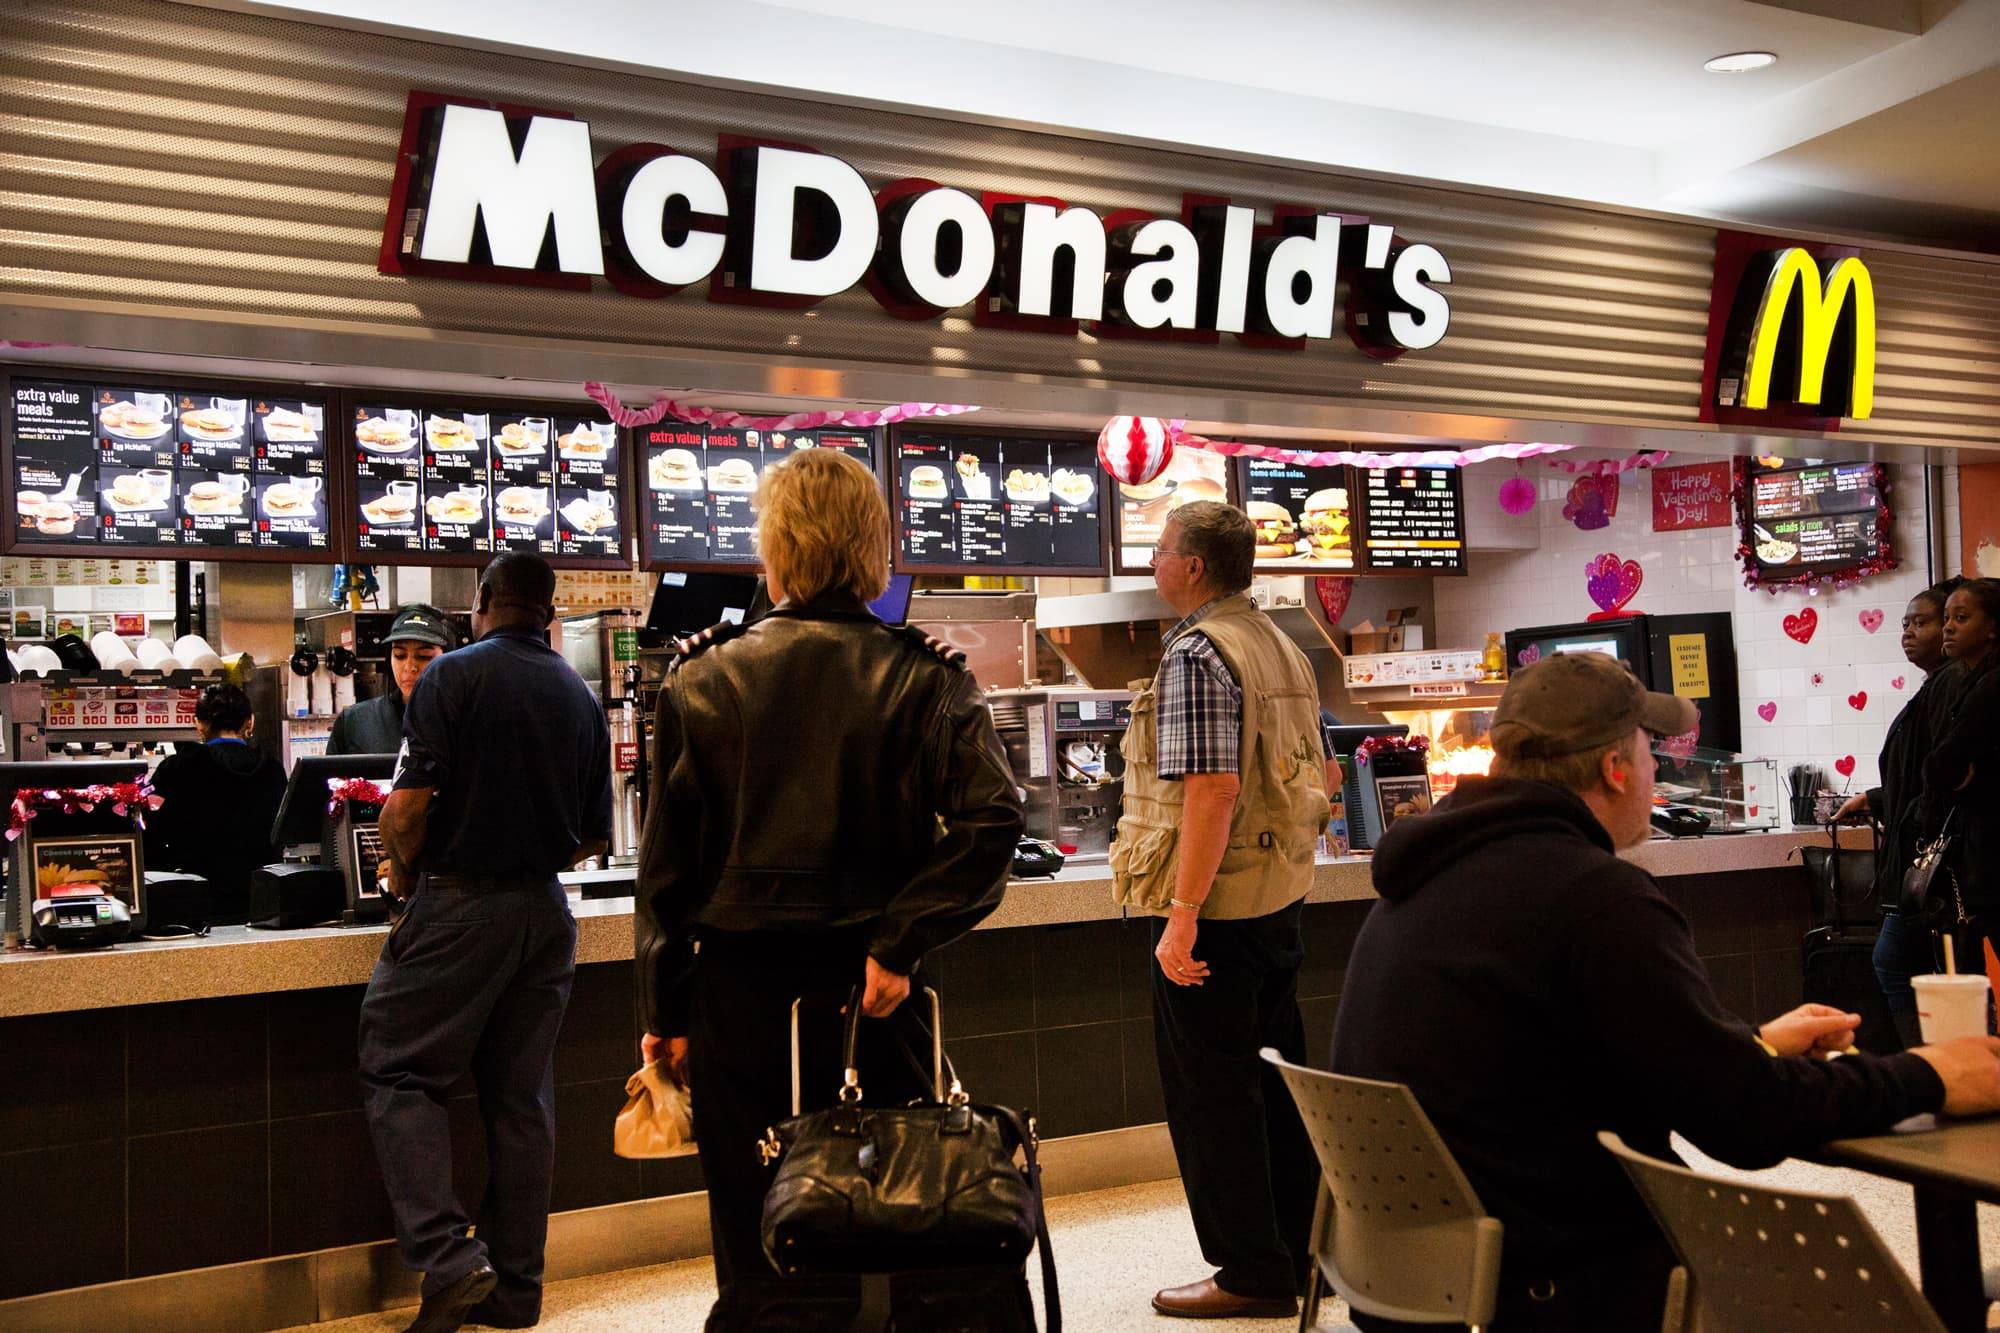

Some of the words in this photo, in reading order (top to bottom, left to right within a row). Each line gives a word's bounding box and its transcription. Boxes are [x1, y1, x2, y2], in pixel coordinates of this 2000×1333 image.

[419, 103, 1452, 350] McDonald's
[16, 388, 46, 402] extra
[48, 389, 80, 404] value
[17, 402, 54, 416] meals
[102, 438, 109, 450] 1
[650, 432, 675, 444] extra
[676, 431, 701, 445] value
[708, 433, 738, 447] meals
[113, 442, 124, 451] Egg
[181, 443, 190, 453] 2
[267, 443, 278, 452] Egg
[205, 448, 216, 456] Egg
[257, 447, 265, 457] 3
[358, 453, 364, 462] 4
[495, 459, 500, 468] 6
[561, 463, 567, 471] 7
[1671, 471, 1712, 490] Happy
[134, 513, 145, 521] Egg
[1674, 503, 1708, 524] Day!
[104, 515, 112, 526] 8
[184, 518, 192, 528] 9
[214, 516, 224, 524] Egg
[259, 520, 269, 531] 10
[359, 524, 367, 534] 11
[1775, 522, 1798, 534] salads
[1800, 522, 1805, 530] &
[1806, 521, 1823, 530] more
[429, 527, 437, 536] 12
[618, 642, 636, 652] tea
[84, 848, 101, 856] your
